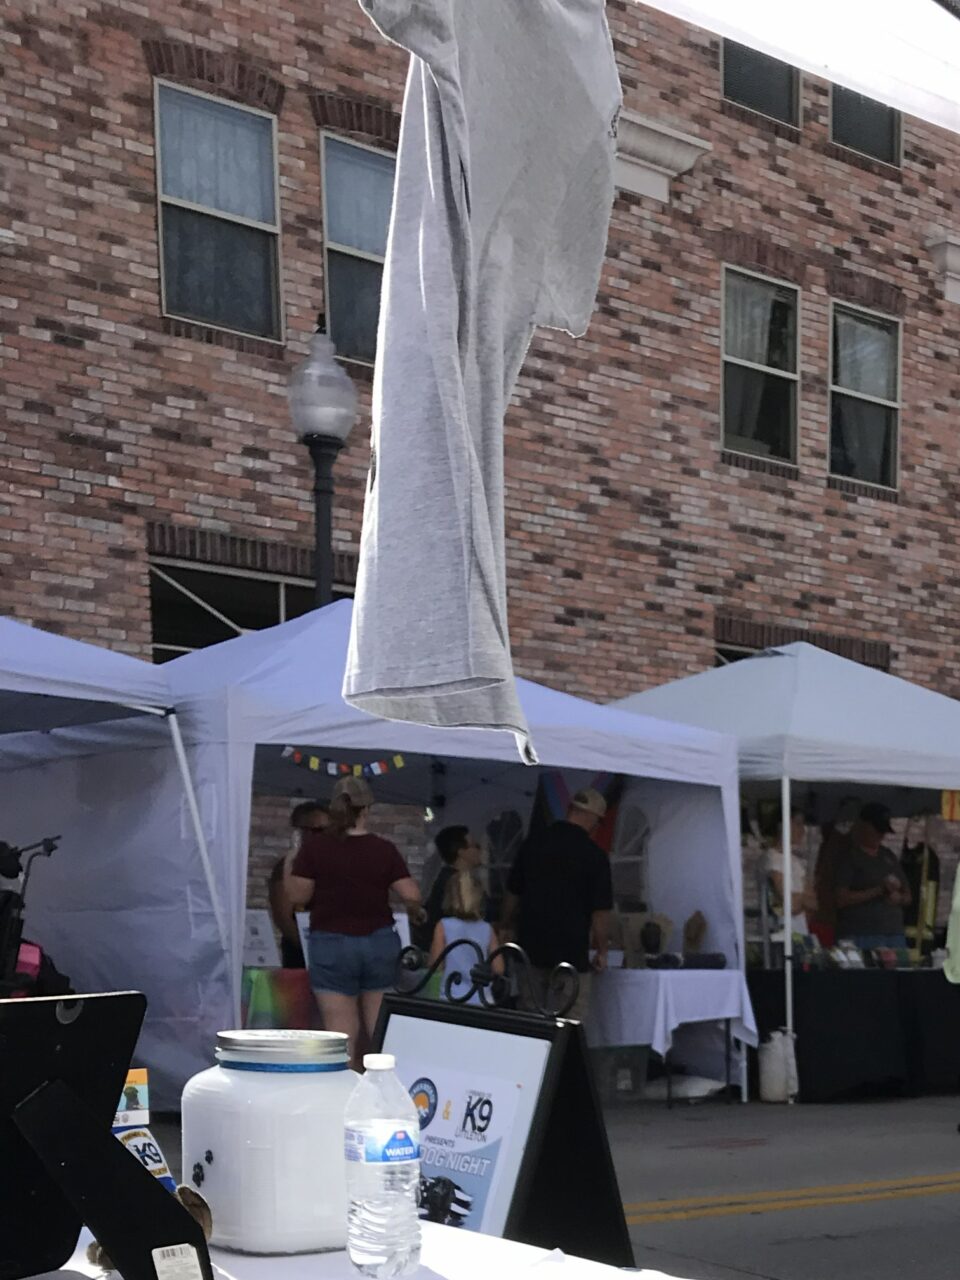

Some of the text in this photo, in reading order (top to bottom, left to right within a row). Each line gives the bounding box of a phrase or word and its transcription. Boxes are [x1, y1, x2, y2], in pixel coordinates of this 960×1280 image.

[462, 1096, 493, 1133] K9
[385, 1146, 414, 1157] WATER
[424, 1134, 456, 1148] PRESENTS
[133, 1142, 163, 1167] K9
[445, 1151, 491, 1176] NIGHT
